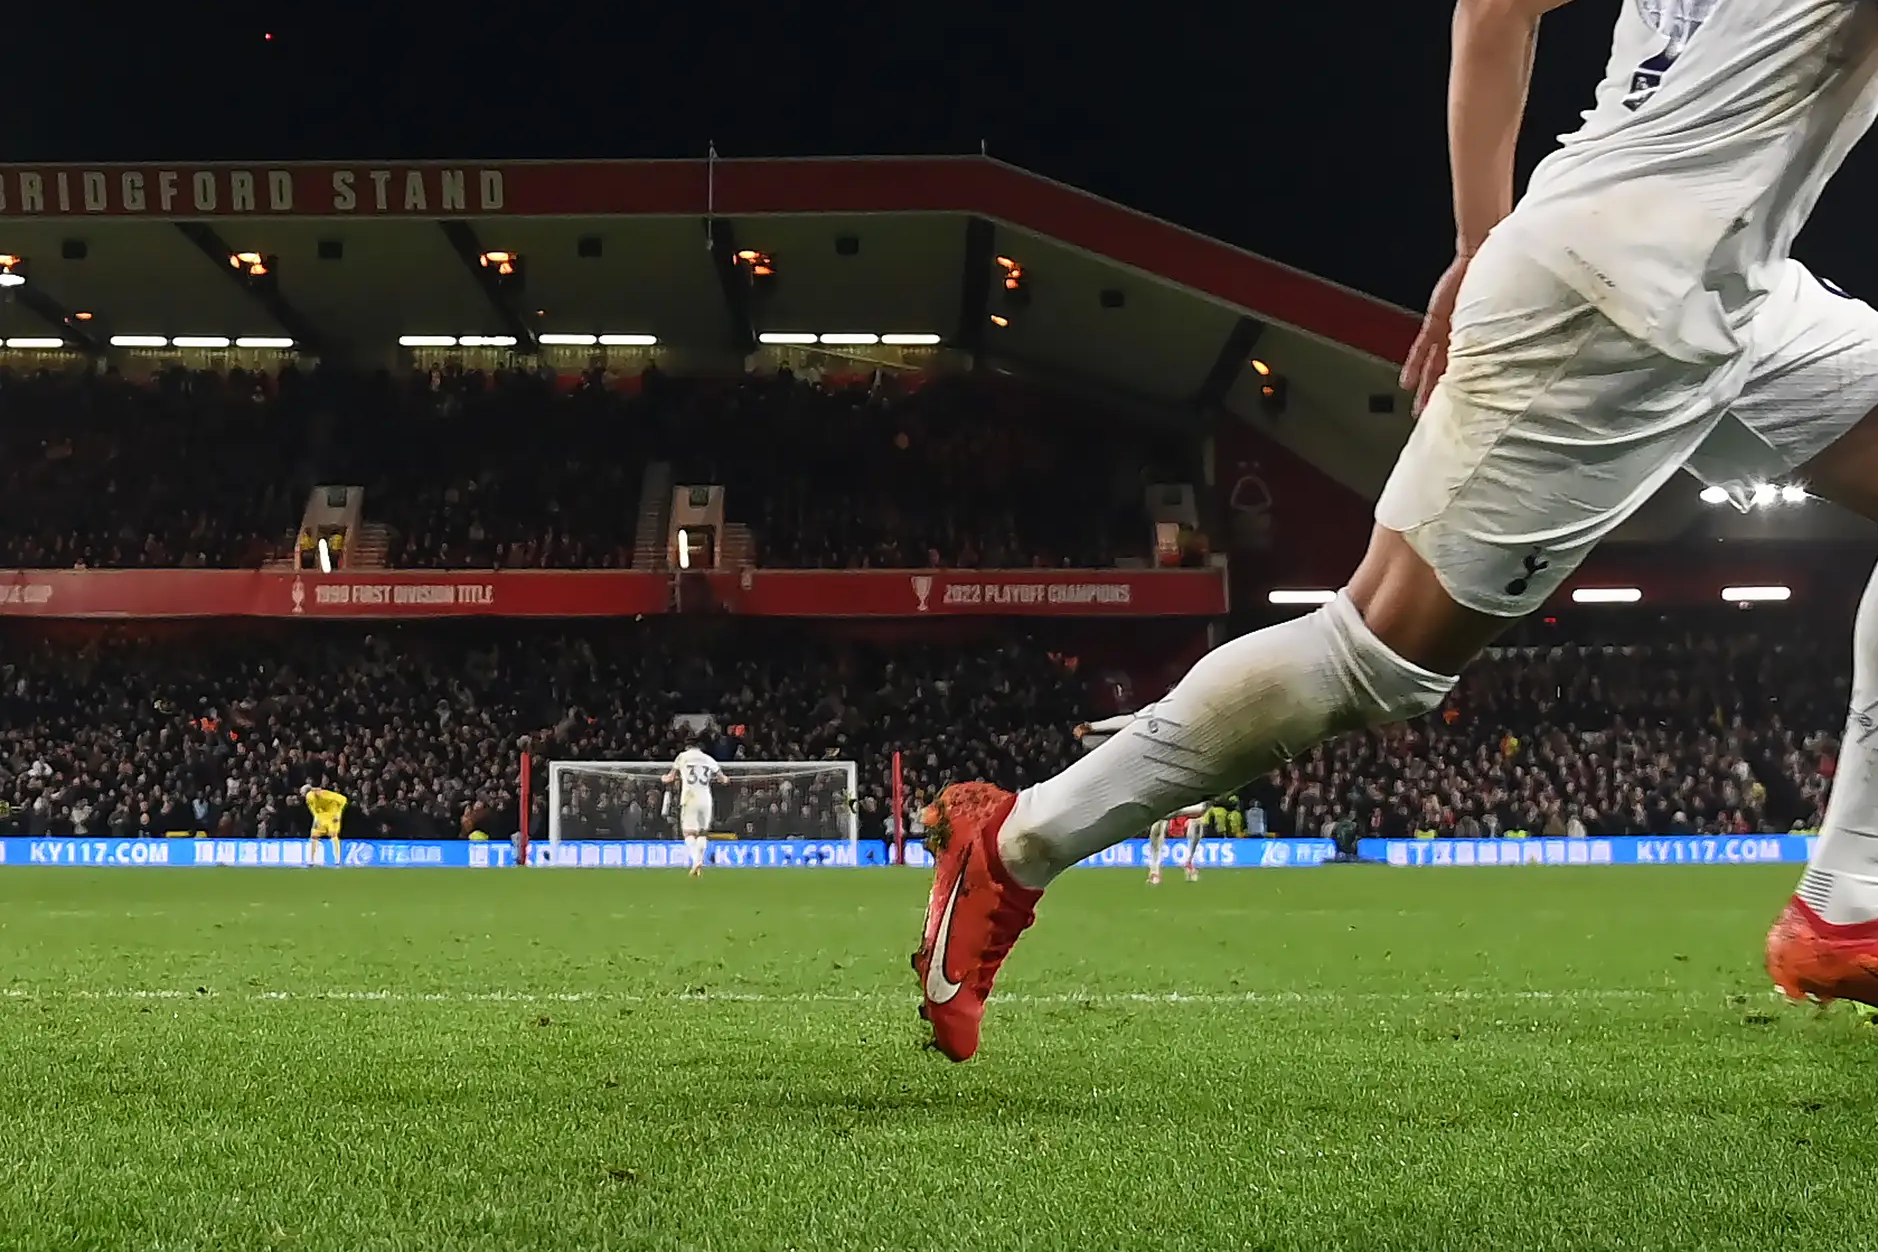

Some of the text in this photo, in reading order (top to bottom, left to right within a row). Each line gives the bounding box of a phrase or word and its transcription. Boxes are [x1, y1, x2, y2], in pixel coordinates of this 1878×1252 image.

[0, 170, 504, 212] RIDGFORD STAND
[352, 584, 392, 604] FIRST
[457, 584, 494, 604] TITLE
[686, 764, 710, 786] 33
[30, 841, 169, 863] KY117.COM
[1636, 840, 1781, 862] KY117.COM
